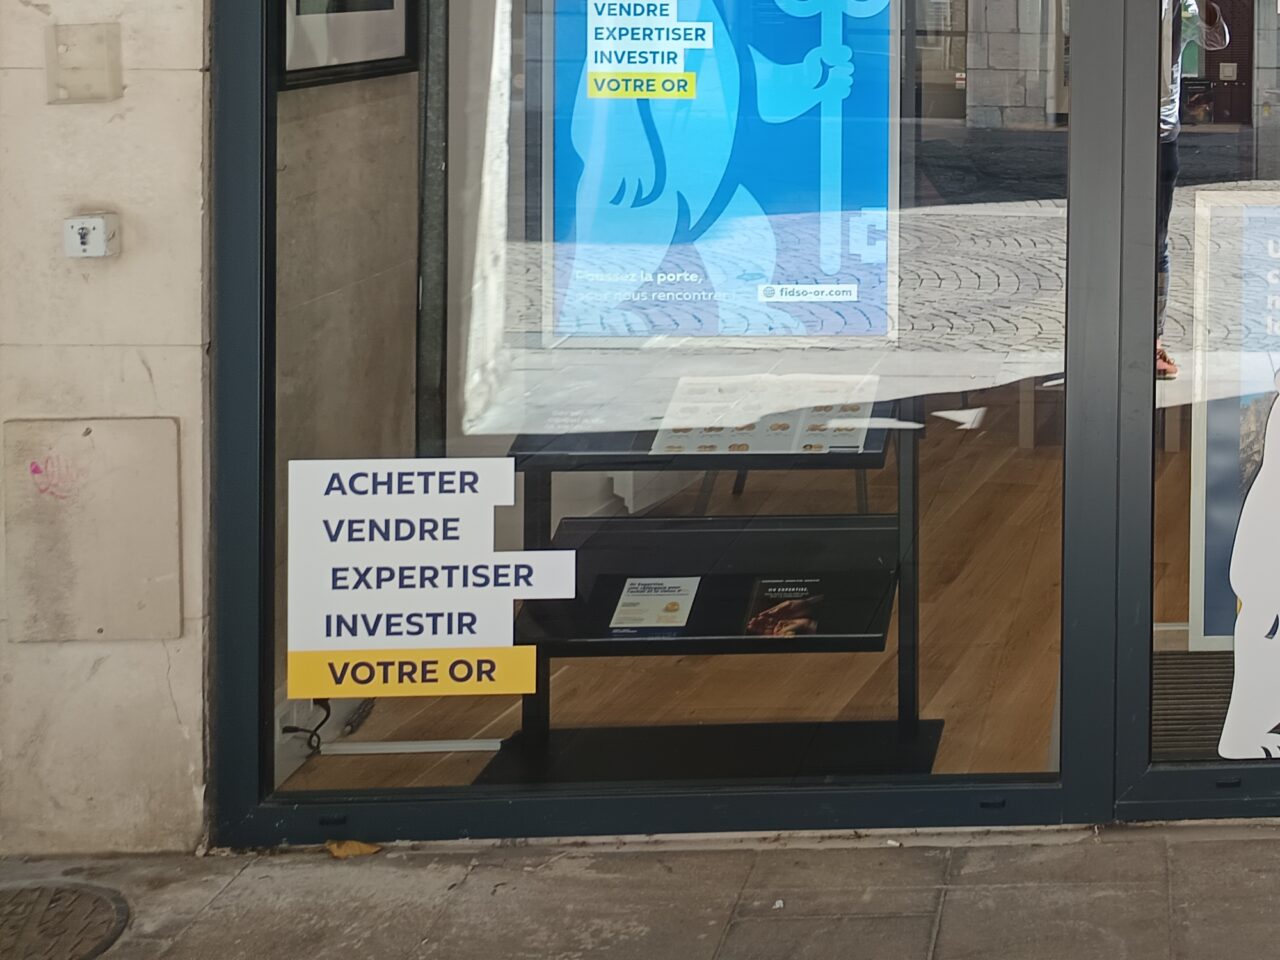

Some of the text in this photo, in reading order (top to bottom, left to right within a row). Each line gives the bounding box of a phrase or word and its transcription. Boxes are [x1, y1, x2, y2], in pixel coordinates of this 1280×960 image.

[594, 3, 669, 16] VENDRE
[594, 27, 706, 41] EXPERTISER
[594, 51, 678, 64] INVESTIR
[594, 78, 688, 92] VOTRE OR
[657, 271, 703, 285] porte,
[779, 287, 852, 297] fidso-or.com
[324, 471, 479, 496] ACHETER
[323, 517, 460, 542] VENDRE
[331, 564, 534, 590] EXPERTISER
[325, 612, 477, 637] INVESTIR
[328, 659, 496, 685] VOTRE OR
